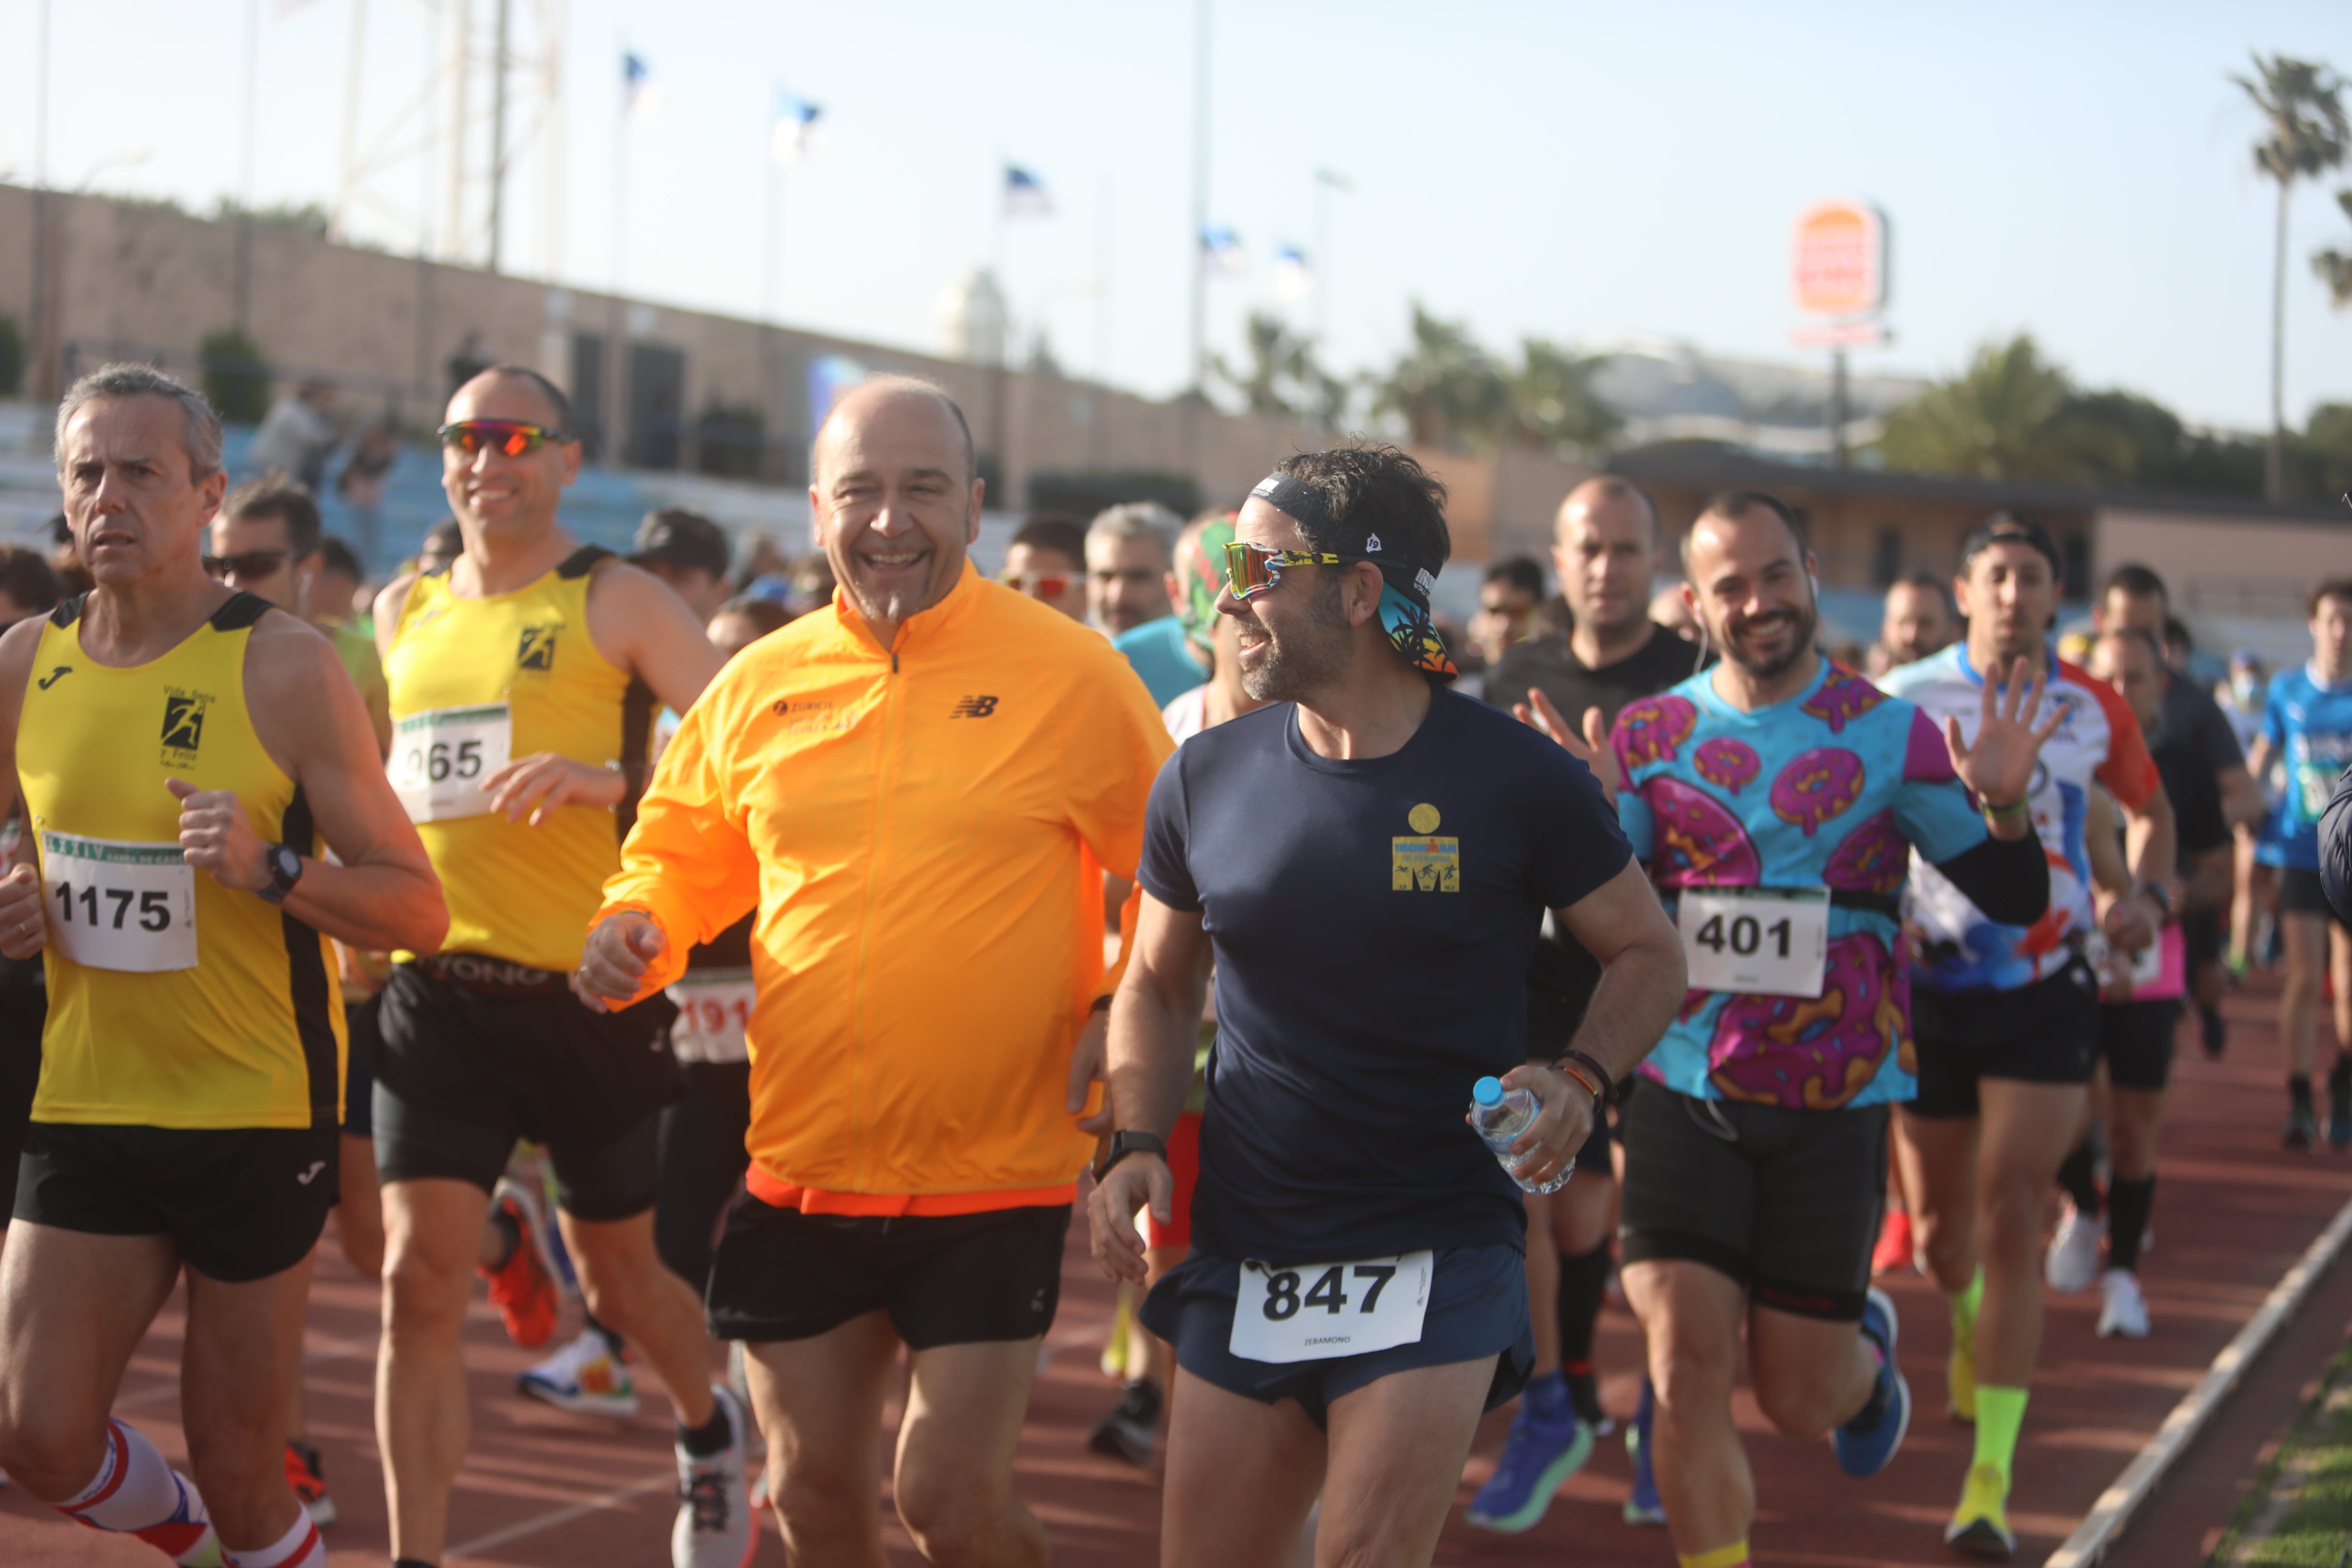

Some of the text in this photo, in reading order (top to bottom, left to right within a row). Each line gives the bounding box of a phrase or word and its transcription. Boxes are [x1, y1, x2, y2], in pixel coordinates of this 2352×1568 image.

[1369, 538, 1378, 548] 19
[1395, 841, 1456, 853] IRONMAN
[56, 877, 171, 932] 1175
[1697, 913, 1790, 958] 401
[1262, 1266, 1396, 1322] 847
[1304, 1336, 1351, 1346] ZEBAMONO
